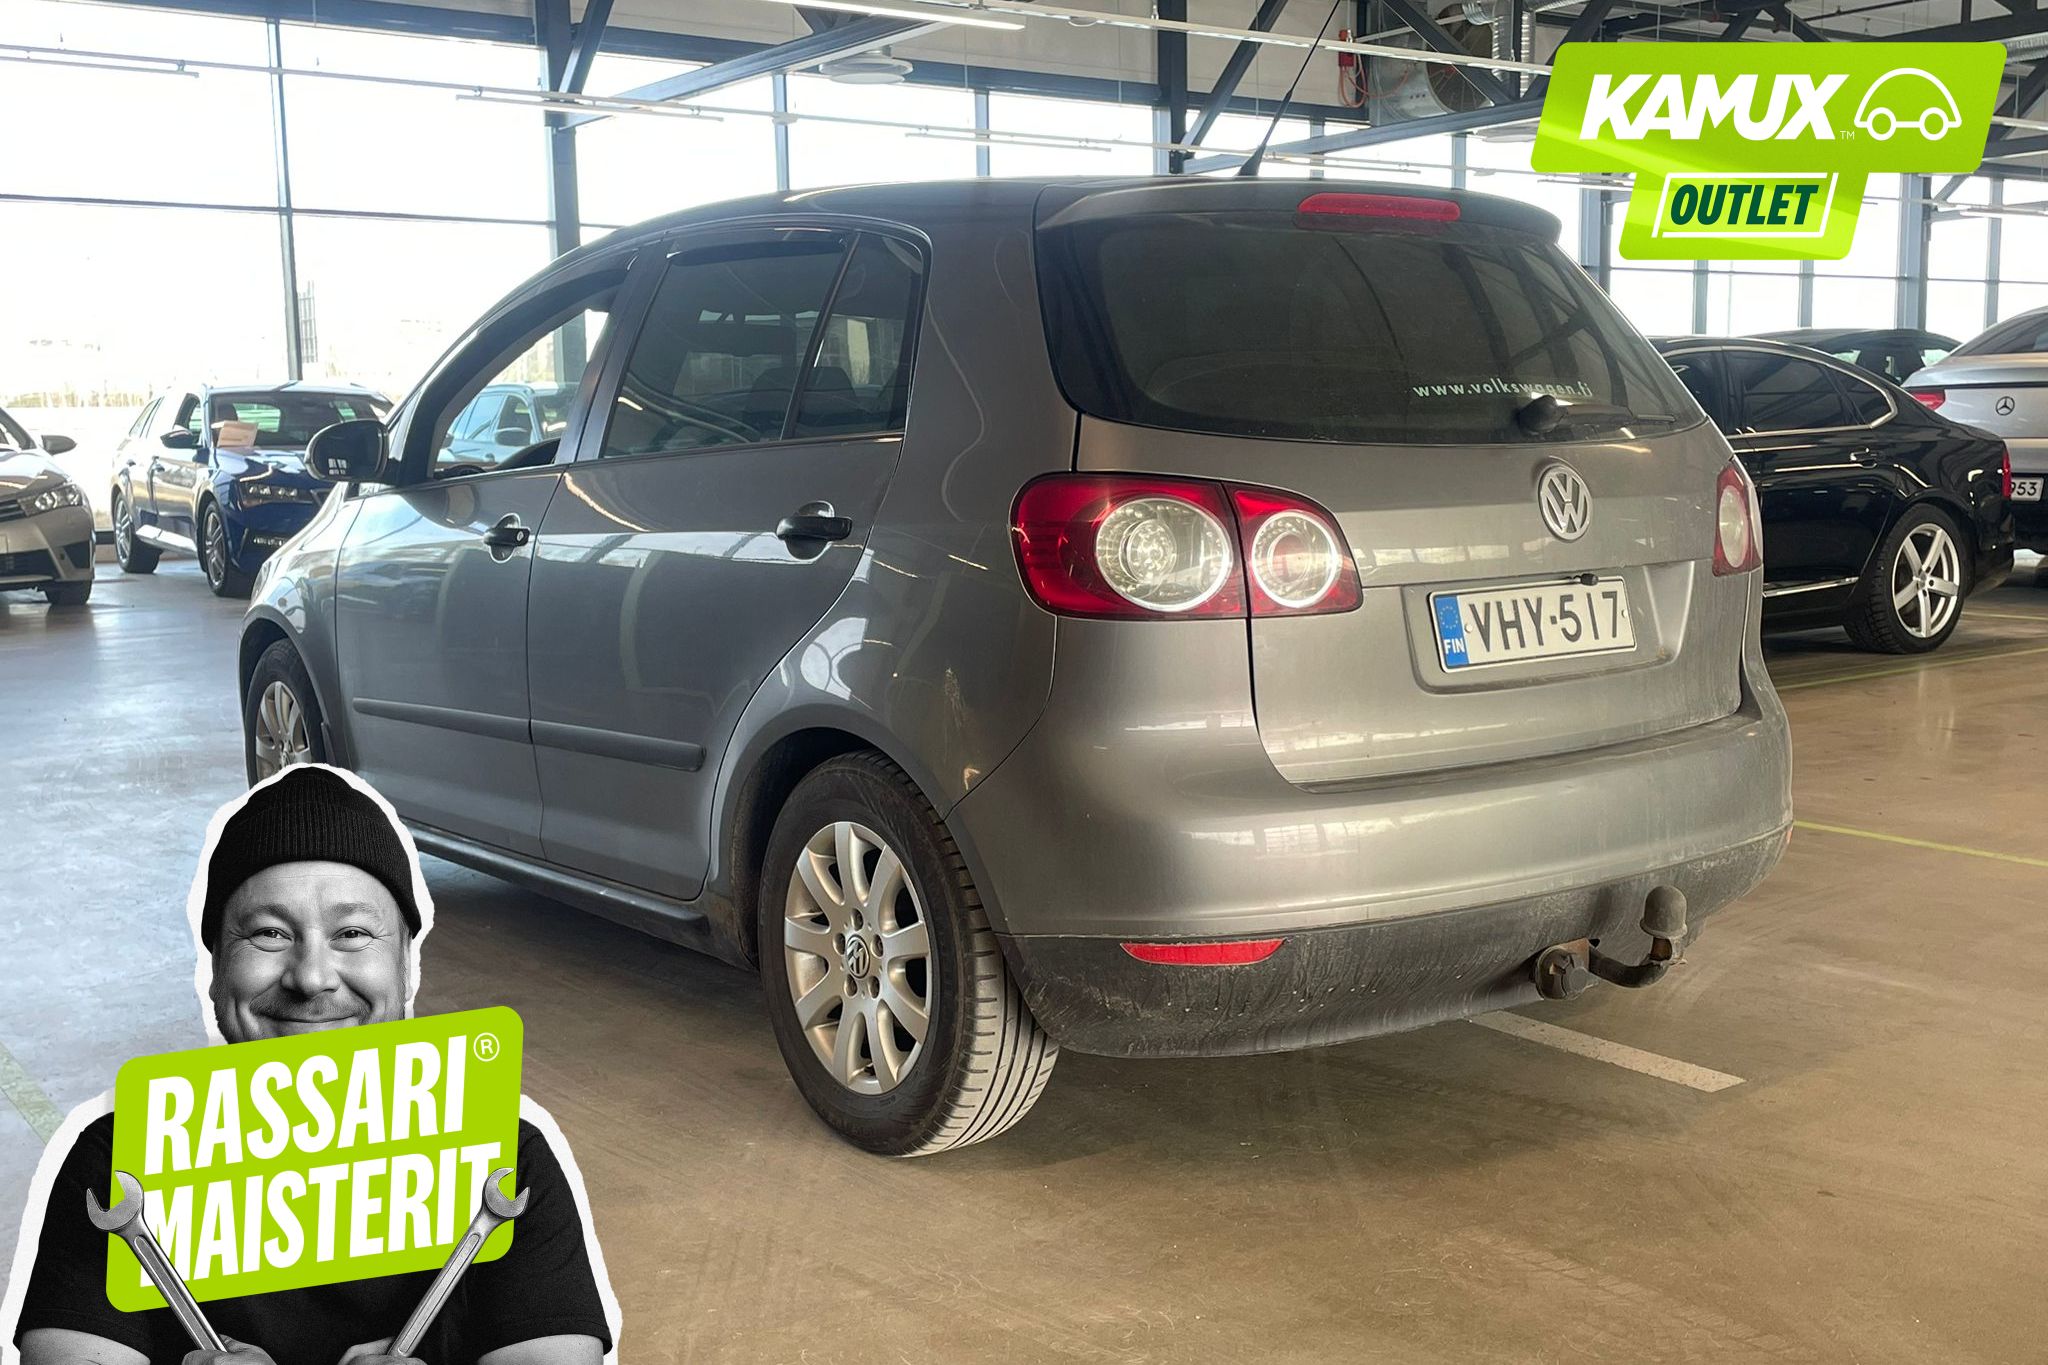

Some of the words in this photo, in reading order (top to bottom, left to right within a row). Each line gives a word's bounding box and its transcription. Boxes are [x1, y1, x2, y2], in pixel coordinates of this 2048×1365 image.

[1413, 378, 1593, 397] www.volkswagen.fi
[1469, 591, 1617, 652] VHY-517
[1443, 637, 1464, 654] FIN
